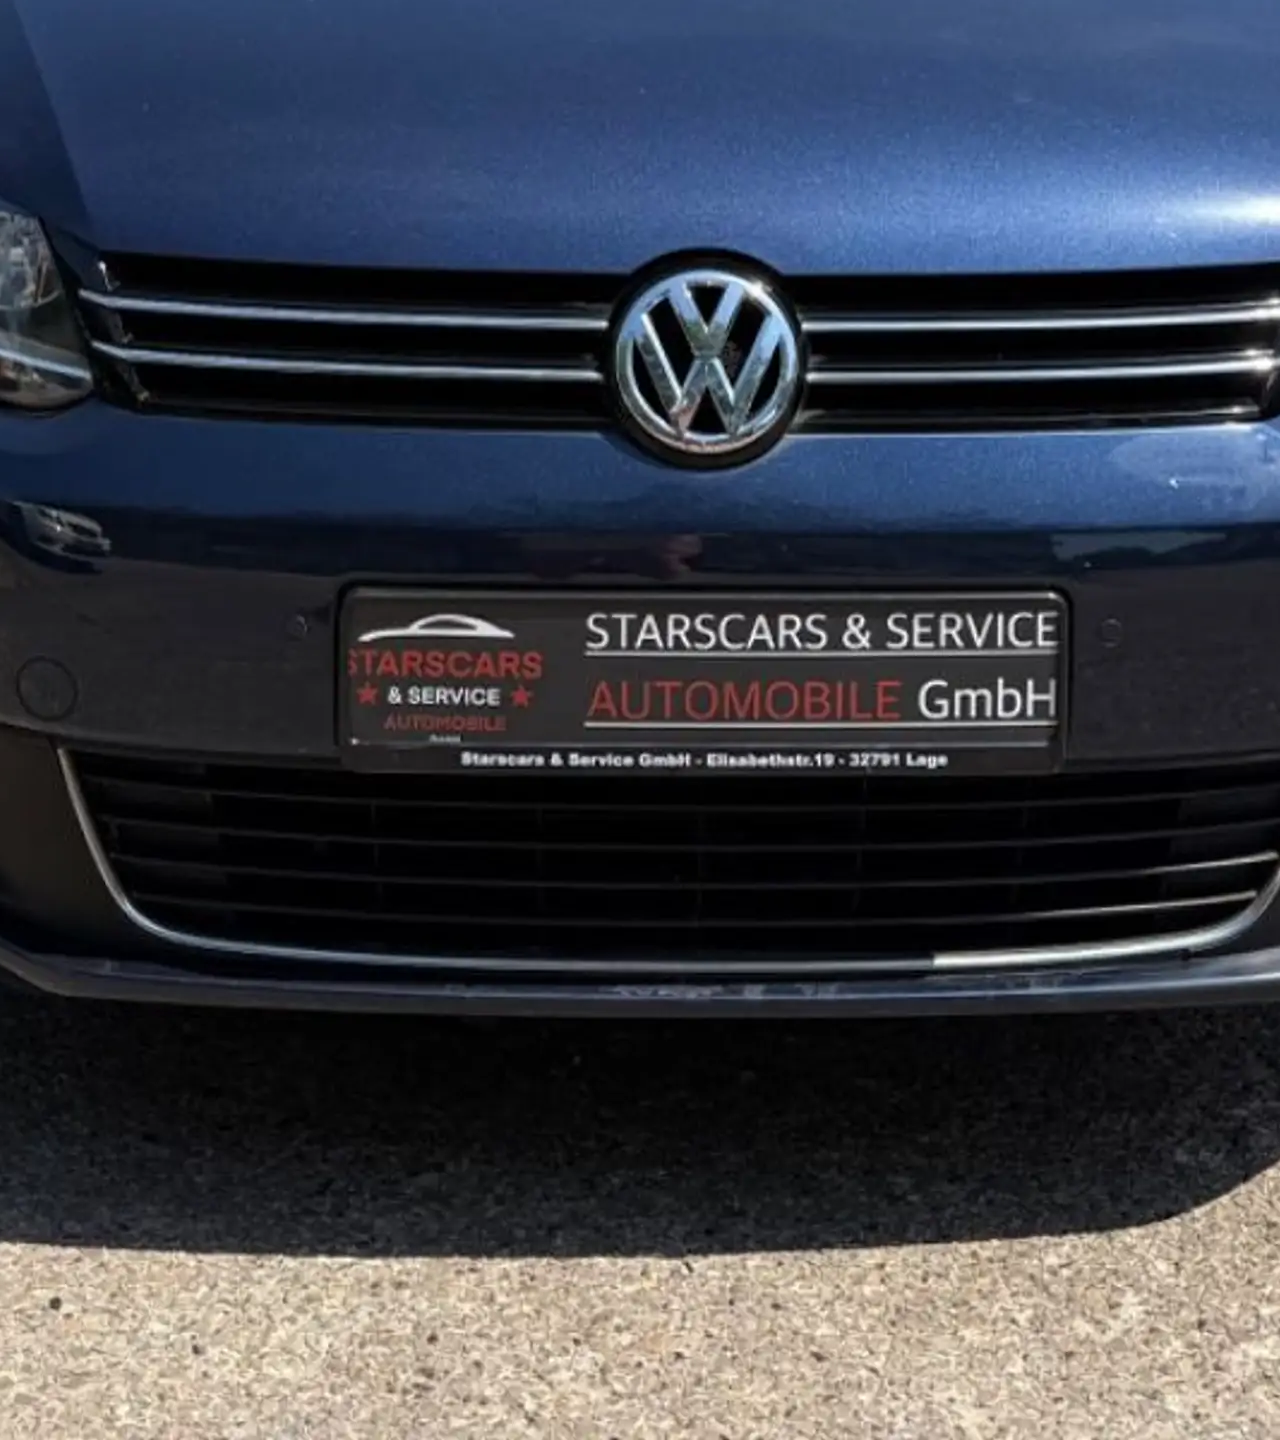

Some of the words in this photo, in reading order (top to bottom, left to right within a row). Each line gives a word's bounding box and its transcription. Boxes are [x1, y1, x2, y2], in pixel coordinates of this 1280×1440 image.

[585, 612, 828, 651] STARSCARS
[841, 612, 872, 650] &
[885, 610, 1058, 650] SERVICE
[387, 685, 402, 705] &
[407, 686, 501, 707] SERVICE
[587, 679, 903, 721] AUTOMOBILE
[917, 676, 1057, 720] GmbH
[383, 712, 507, 732] AUTOMOBILE
[461, 751, 544, 768] Starscars
[550, 751, 564, 768] &
[568, 751, 635, 768] Service
[638, 751, 691, 768] GmbH
[849, 751, 900, 768] 32791
[905, 751, 950, 770] Lage
